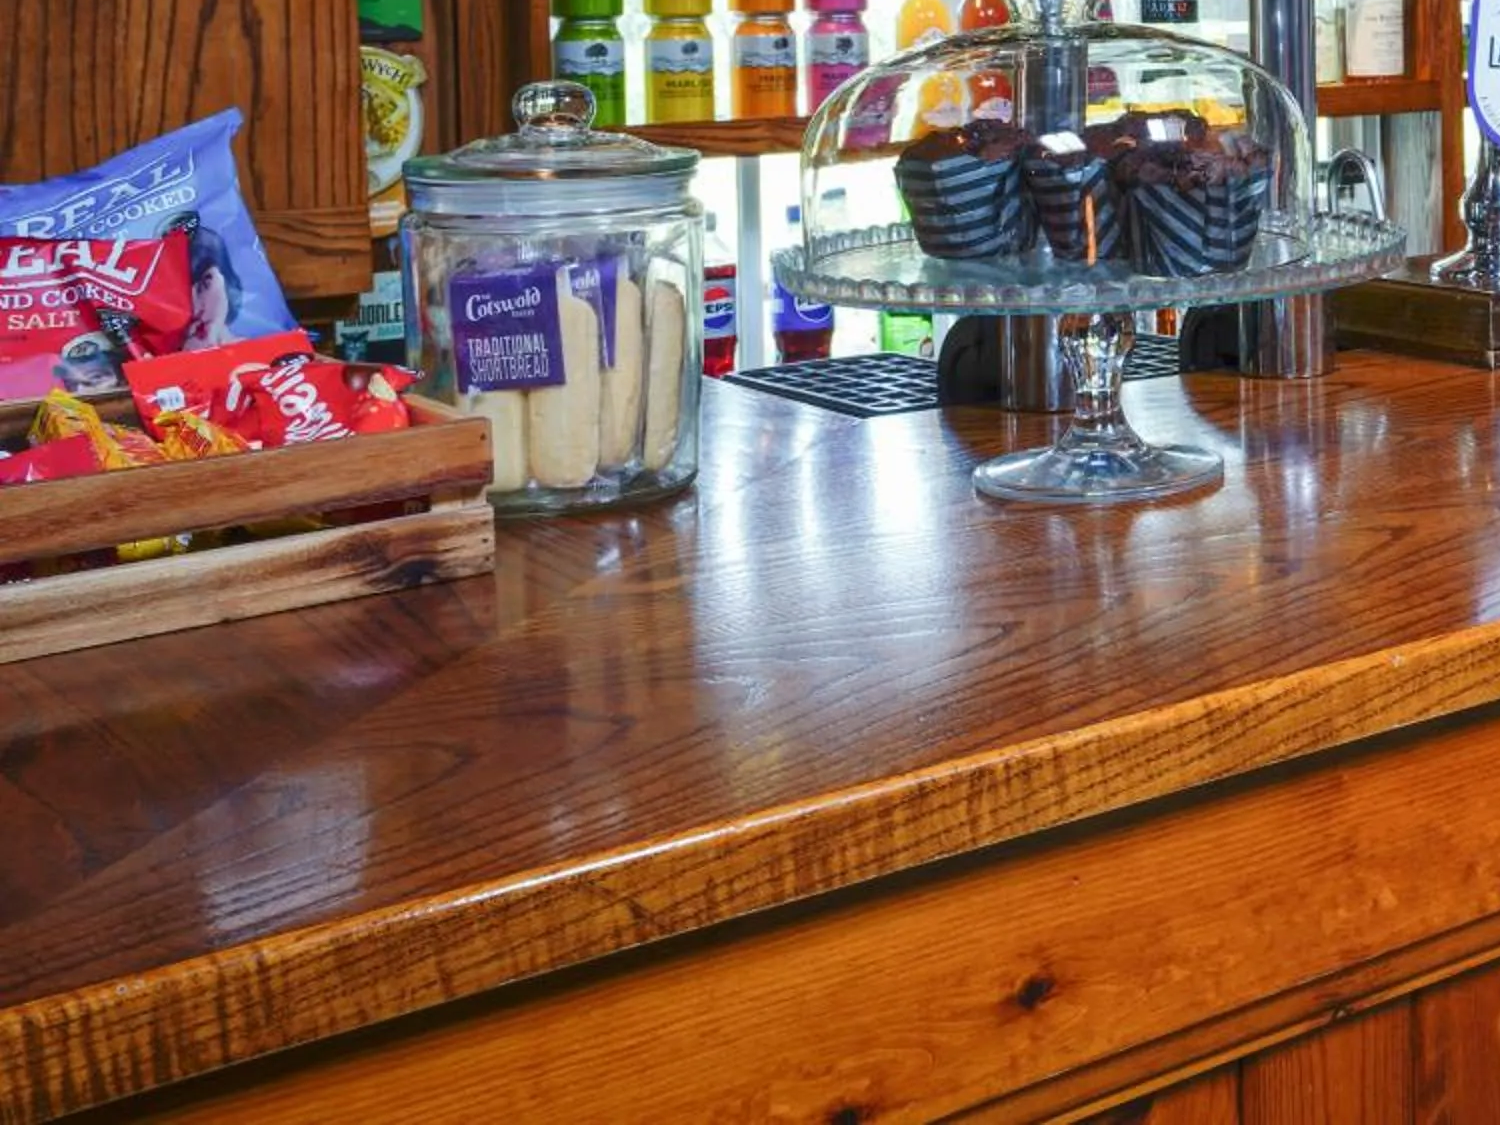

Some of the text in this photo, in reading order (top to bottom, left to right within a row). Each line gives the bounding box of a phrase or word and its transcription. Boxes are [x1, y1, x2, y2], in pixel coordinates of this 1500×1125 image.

[15, 157, 183, 241] REAL
[93, 185, 197, 240] COOKED
[0, 237, 140, 285] EAL
[0, 283, 135, 312] ND COOKED
[466, 286, 542, 323] Cotswold
[7, 312, 81, 330] SALT
[468, 333, 549, 361] TRADITIONAL
[470, 355, 549, 384] SHORTBREAD
